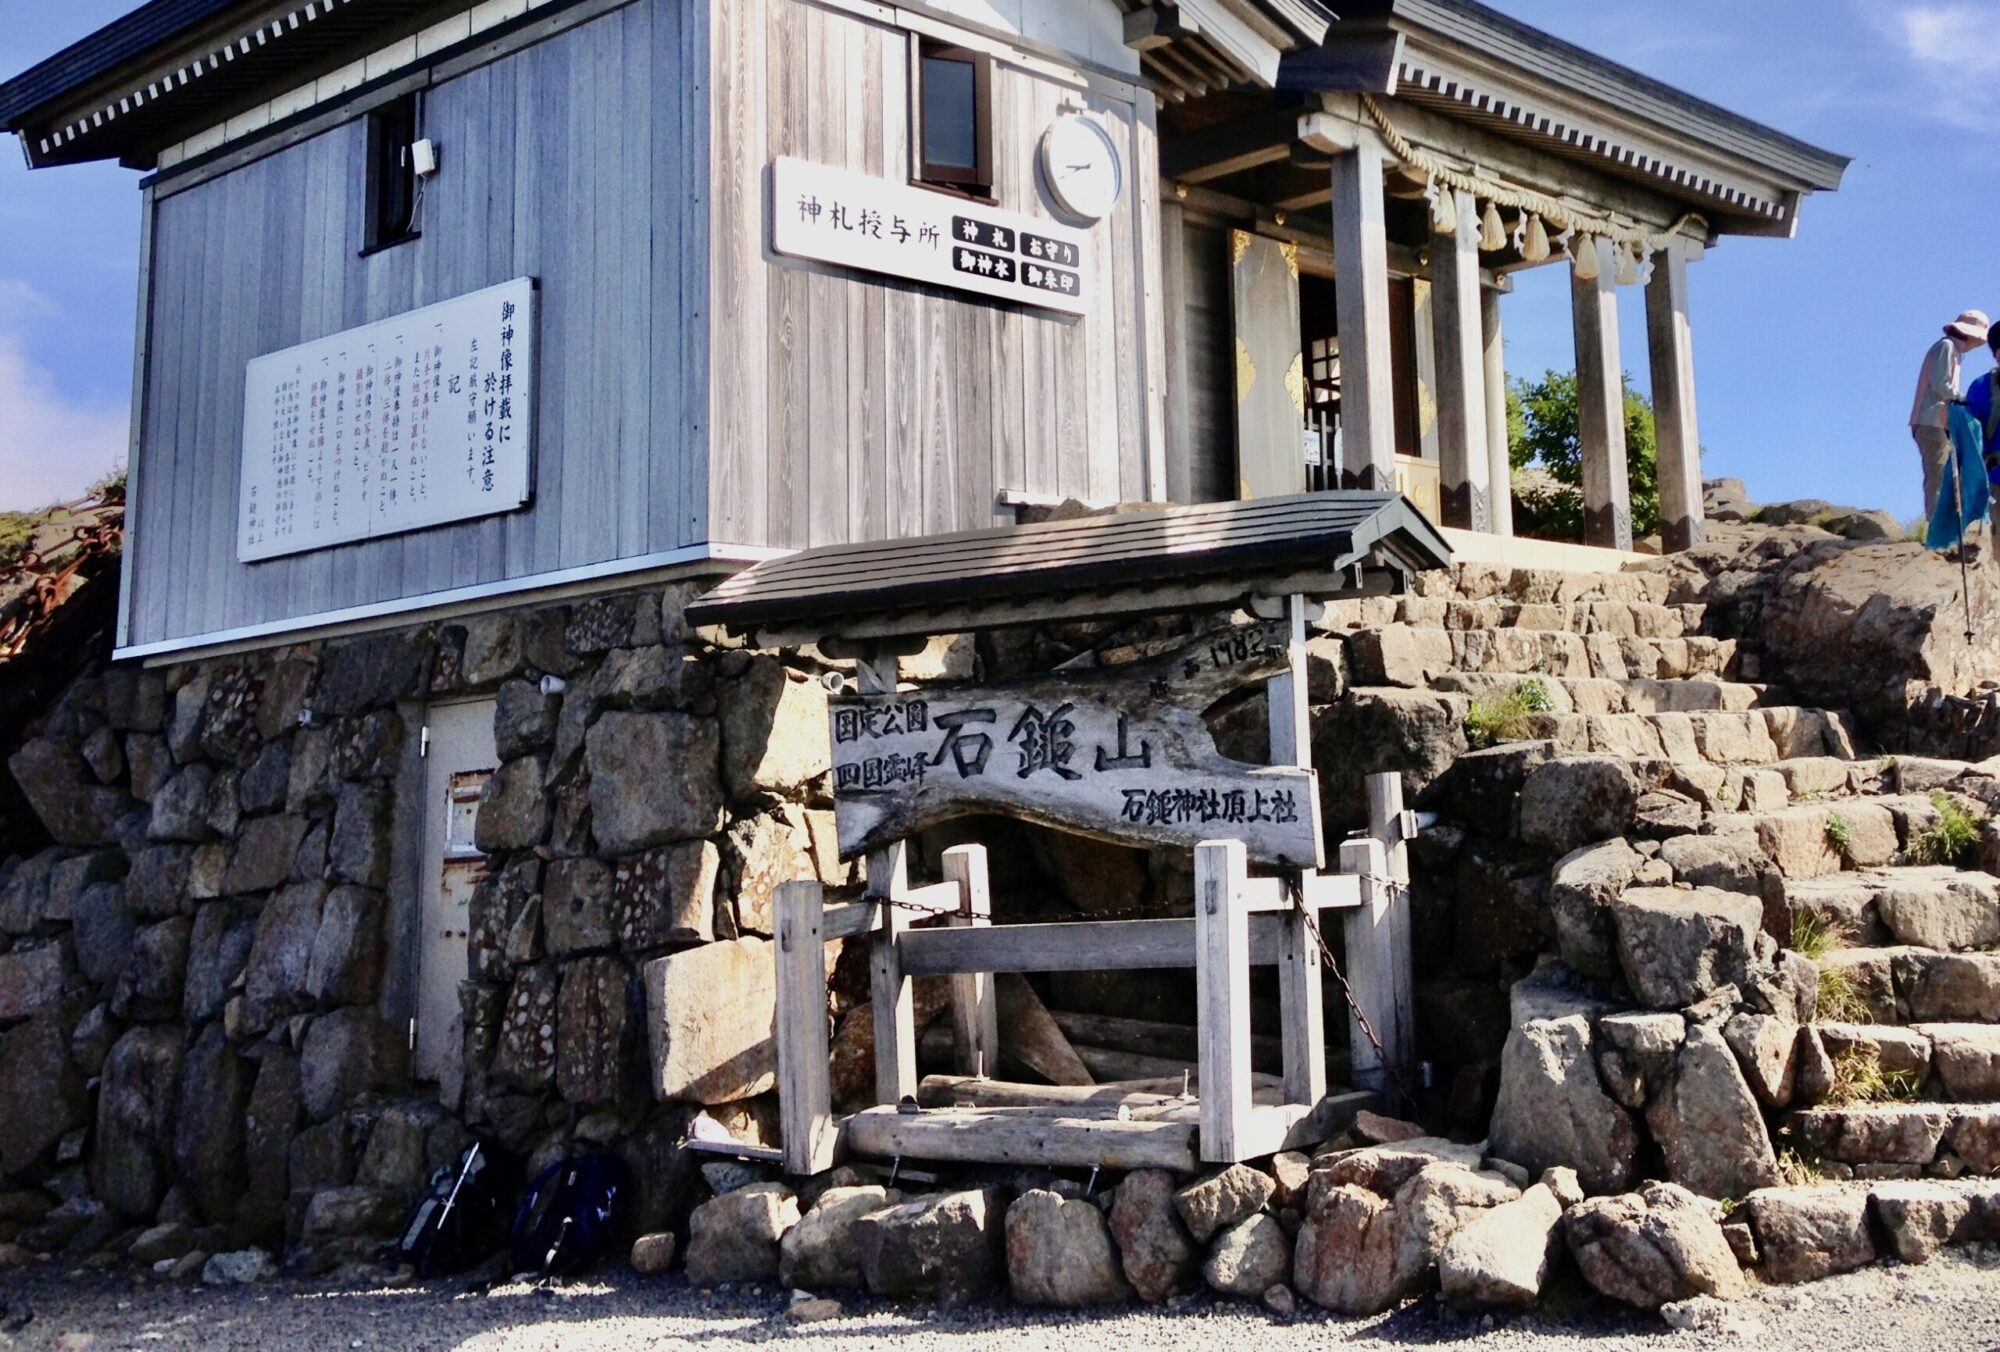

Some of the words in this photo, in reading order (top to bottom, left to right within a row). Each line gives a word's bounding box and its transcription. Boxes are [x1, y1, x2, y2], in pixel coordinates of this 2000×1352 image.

[797, 194, 940, 250] 神札授与所
[963, 221, 1008, 248] 神札
[960, 252, 1009, 278] 御神水
[1029, 238, 1072, 264] お守り
[1028, 265, 1074, 293] 御朱印
[448, 374, 461, 394] 記
[481, 371, 498, 491] 於ける注意
[835, 699, 929, 744] 国定公園
[933, 702, 1151, 782] 石鎚山
[836, 752, 929, 789] 四国霊峰
[1121, 787, 1299, 825] 石鎚神社頂上社
